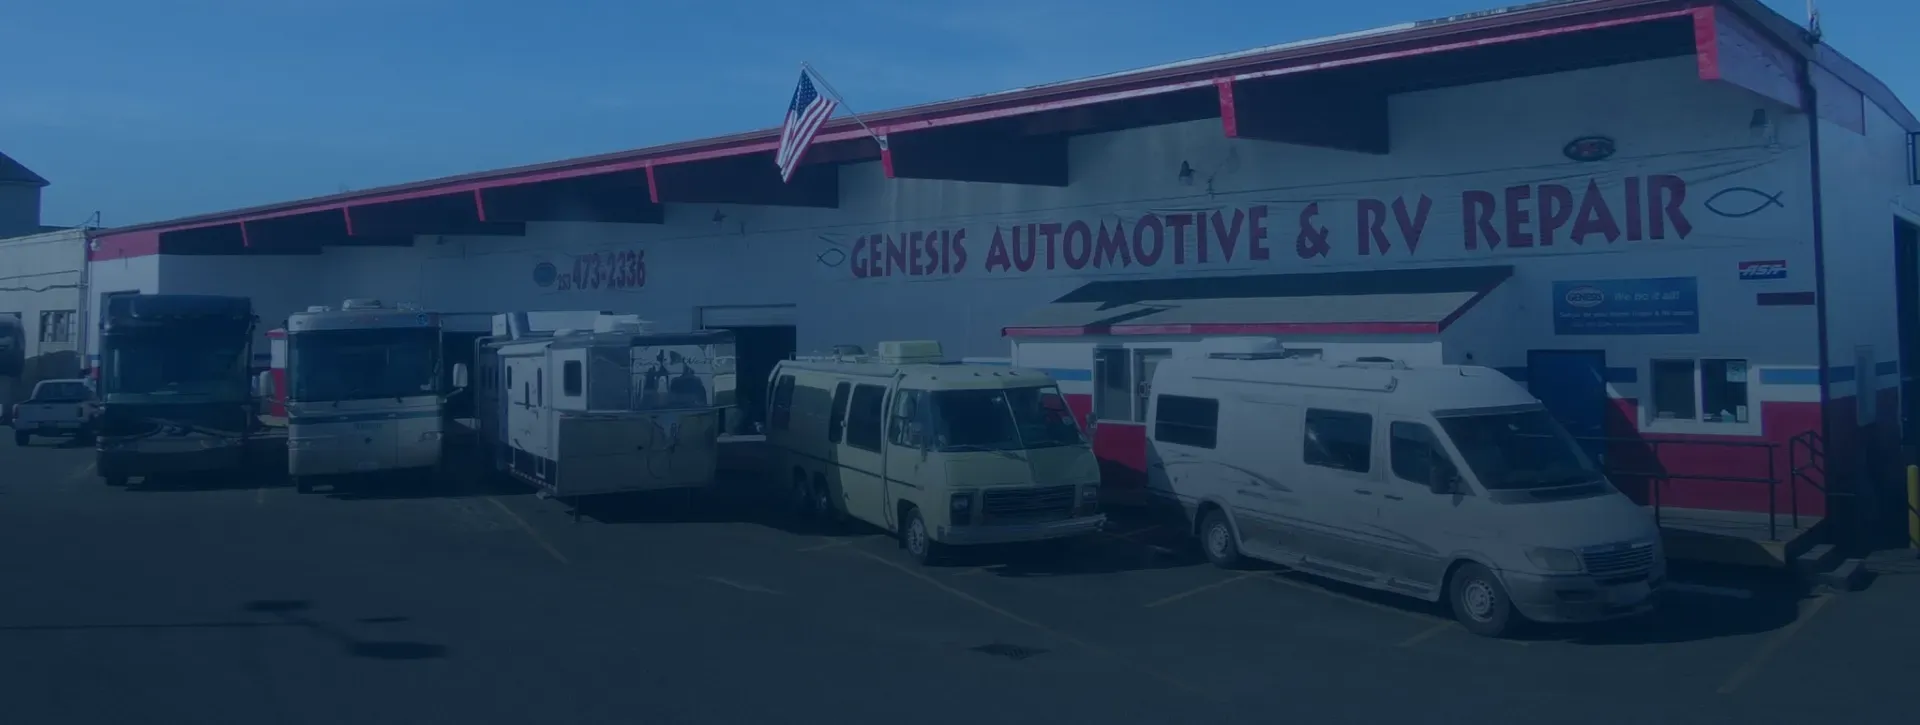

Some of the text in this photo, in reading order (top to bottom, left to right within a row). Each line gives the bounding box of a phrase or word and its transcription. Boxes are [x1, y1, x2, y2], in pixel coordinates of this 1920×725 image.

[850, 173, 1693, 279] GENESIS AUTOMOTIVE & RV REPAIR
[573, 250, 646, 290] 473-2336
